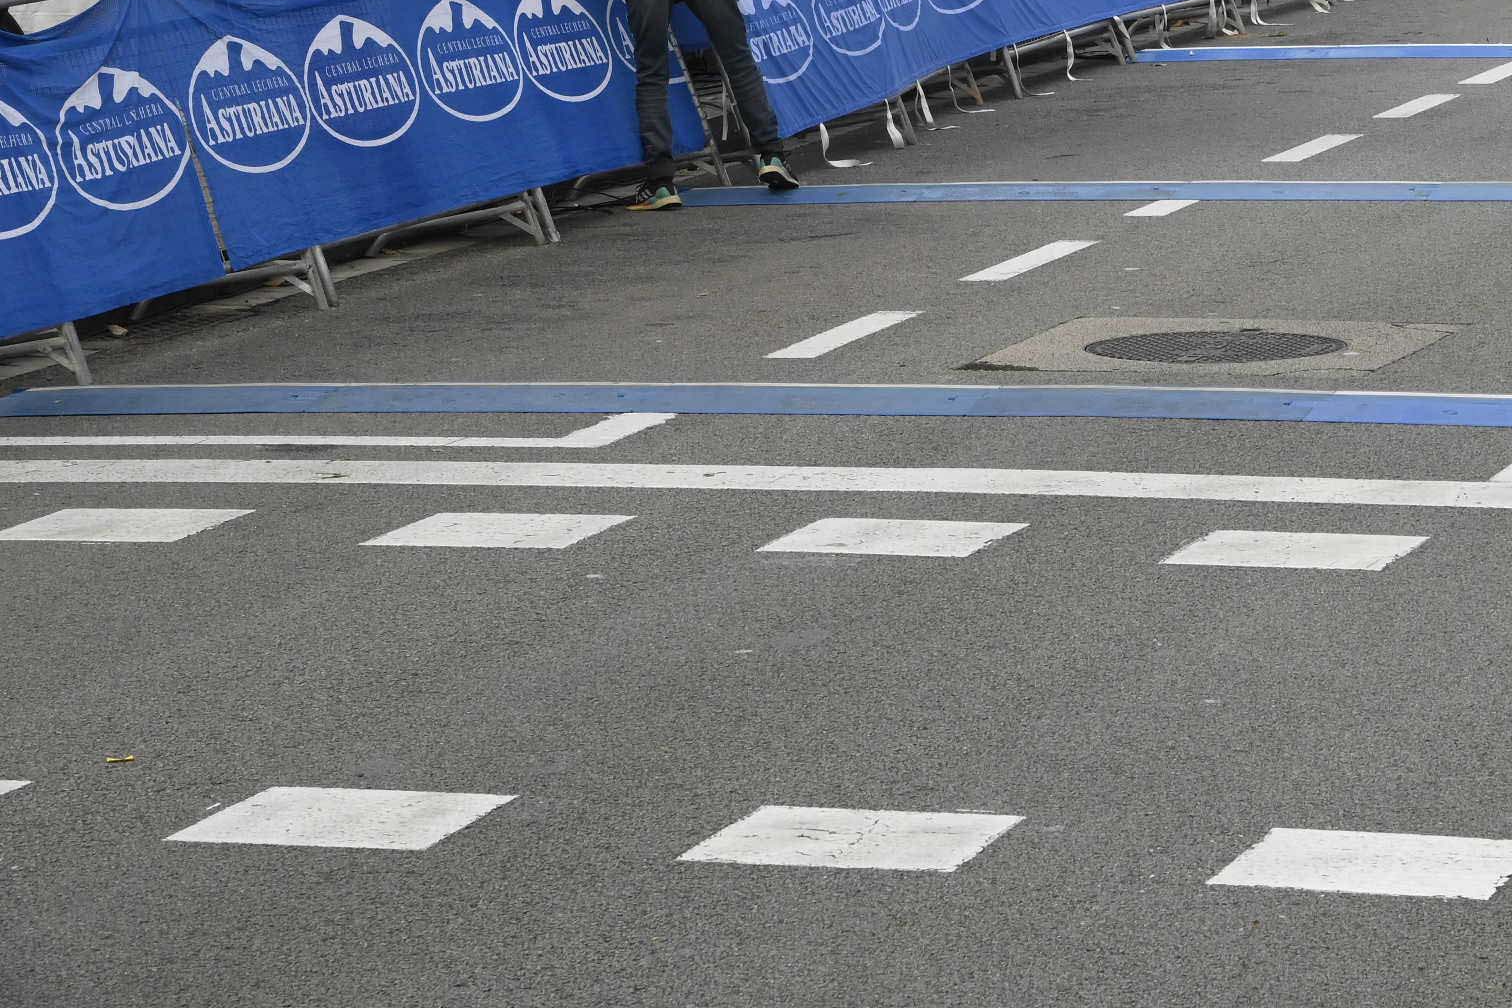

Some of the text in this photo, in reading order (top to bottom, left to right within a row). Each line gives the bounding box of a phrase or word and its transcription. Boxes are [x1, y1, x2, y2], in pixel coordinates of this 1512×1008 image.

[325, 53, 399, 78] CENTRAL LECHERA
[428, 47, 518, 94] ASTURIANA
[523, 31, 607, 78] ASTURIANA
[212, 76, 289, 101] CENTRAL LECHERA
[315, 70, 415, 120] ASTURIANA
[201, 93, 305, 146] ASTURIANA
